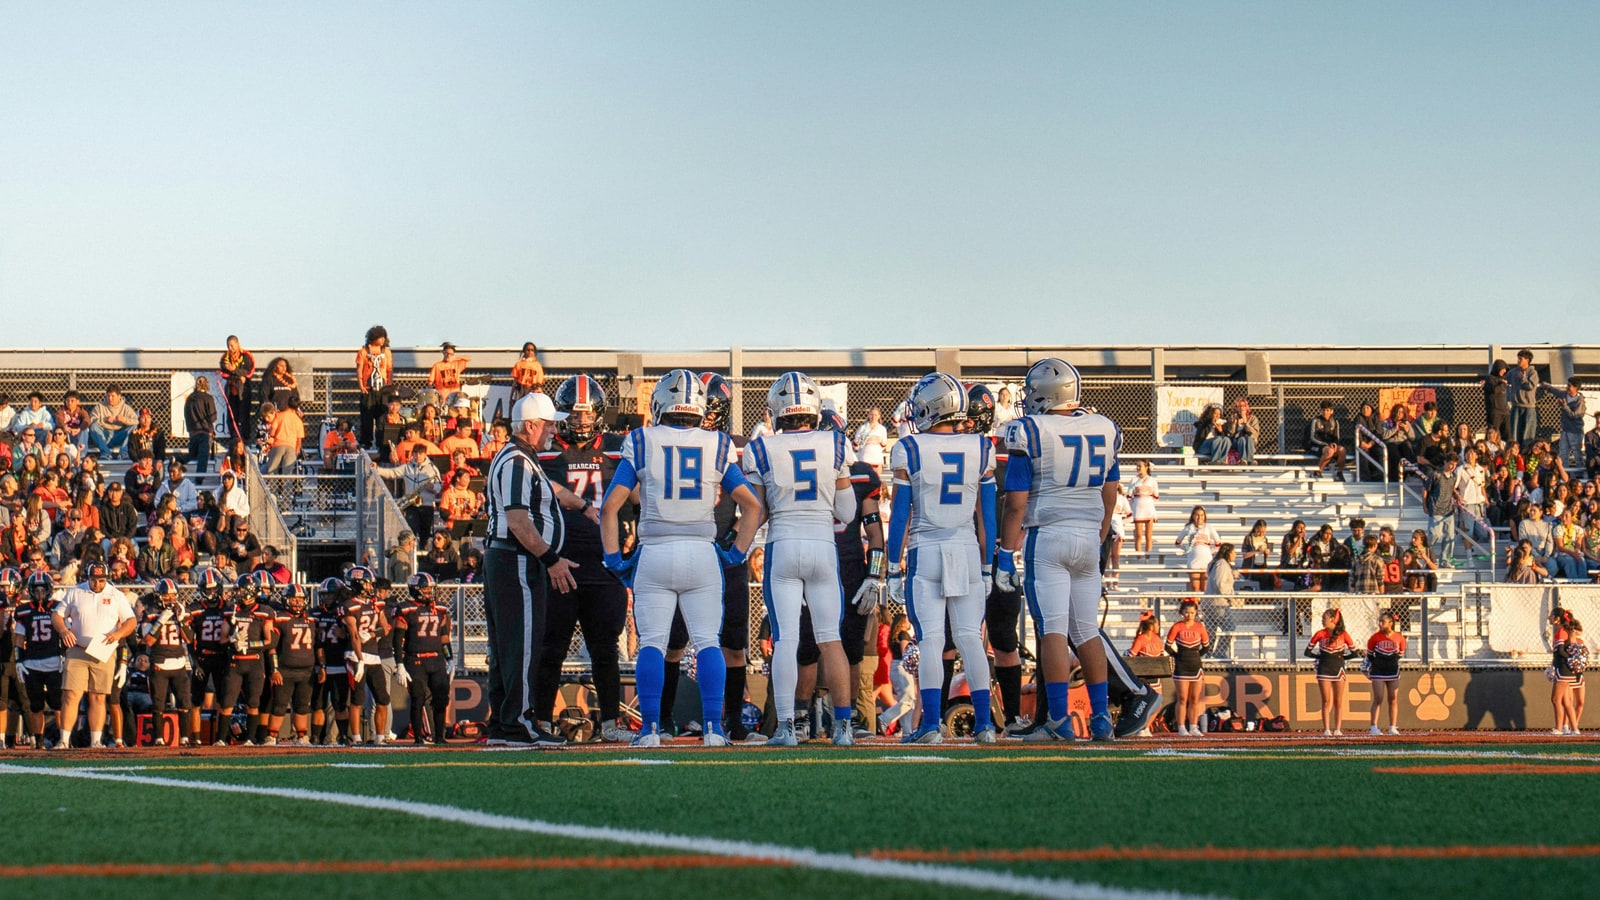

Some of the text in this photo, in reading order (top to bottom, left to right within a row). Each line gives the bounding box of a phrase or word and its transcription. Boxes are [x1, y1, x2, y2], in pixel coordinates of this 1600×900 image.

[674, 404, 701, 413] Riddell
[660, 445, 704, 501] 19
[787, 448, 818, 501] 5
[1058, 434, 1107, 488] 75
[566, 470, 605, 509] 71
[938, 451, 965, 505] 2
[31, 620, 52, 641] 15
[160, 624, 180, 645] 12
[201, 620, 224, 642] 22
[290, 626, 313, 650] 74
[416, 615, 440, 638] 77
[1197, 674, 1373, 721] PRIDE
[142, 715, 175, 747] 50
